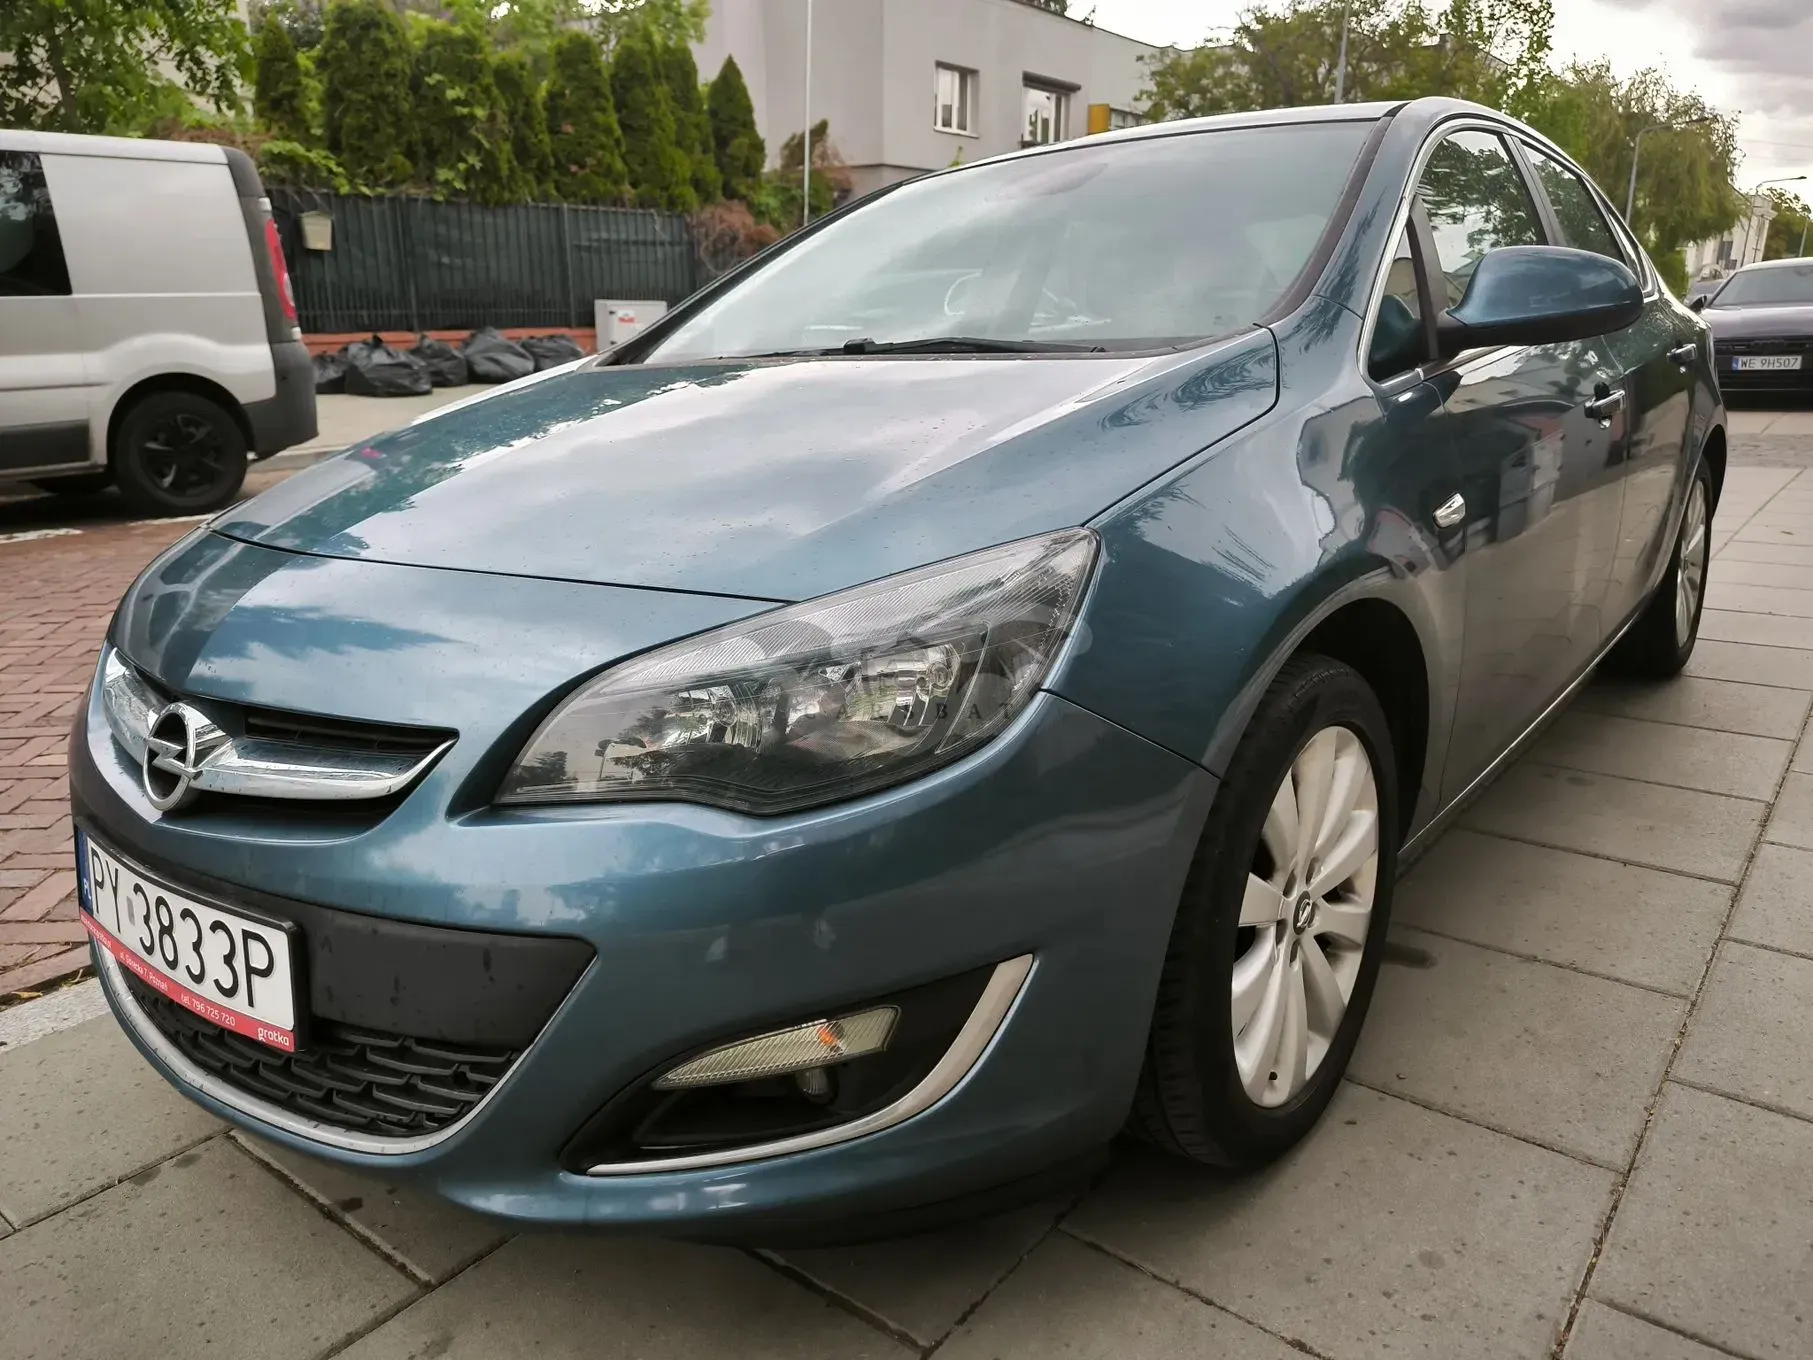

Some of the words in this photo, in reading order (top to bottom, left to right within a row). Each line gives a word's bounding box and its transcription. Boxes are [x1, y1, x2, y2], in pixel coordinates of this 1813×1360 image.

[1741, 357, 1756, 369] WE
[1761, 357, 1799, 369] 9H507
[91, 846, 121, 934] PY
[132, 882, 275, 1008] 3833P
[192, 999, 205, 1014] 796
[206, 1005, 220, 1020] 725
[221, 1012, 236, 1027] 720
